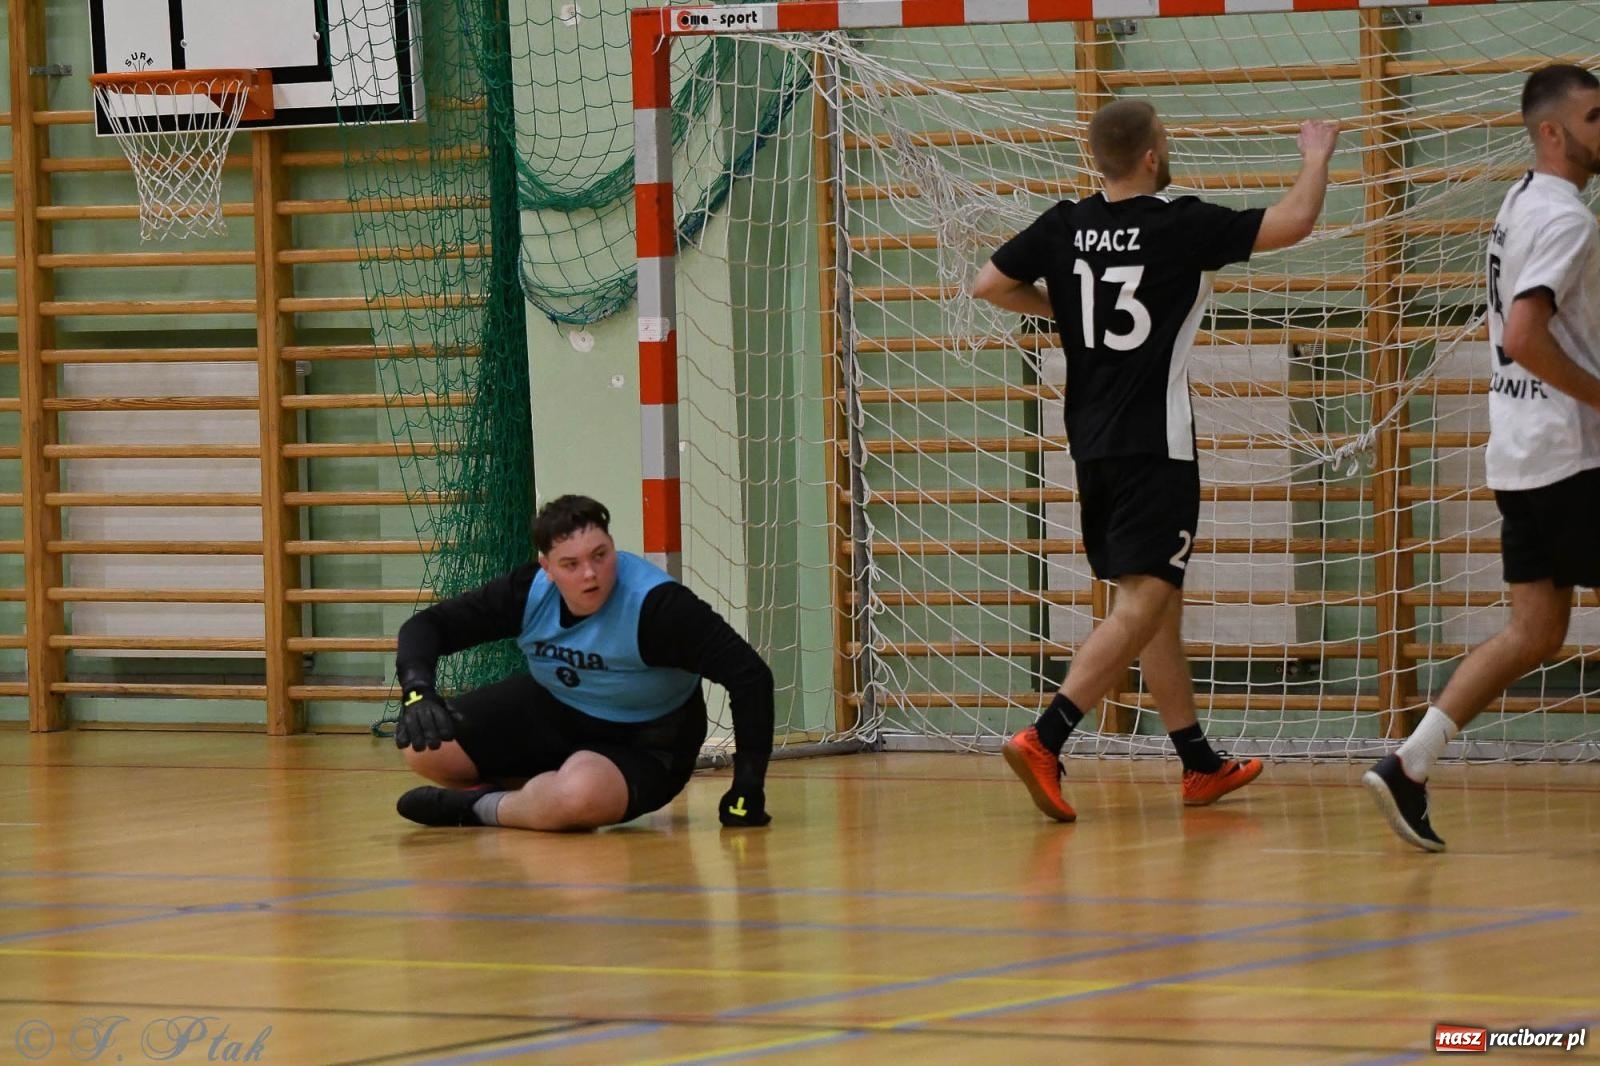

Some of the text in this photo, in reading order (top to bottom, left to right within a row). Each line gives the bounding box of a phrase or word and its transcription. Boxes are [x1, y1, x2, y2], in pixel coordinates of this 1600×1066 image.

[720, 11, 758, 28] sport
[124, 51, 154, 67] SURE
[1072, 258, 1152, 351] 13
[1168, 530, 1191, 570] 2
